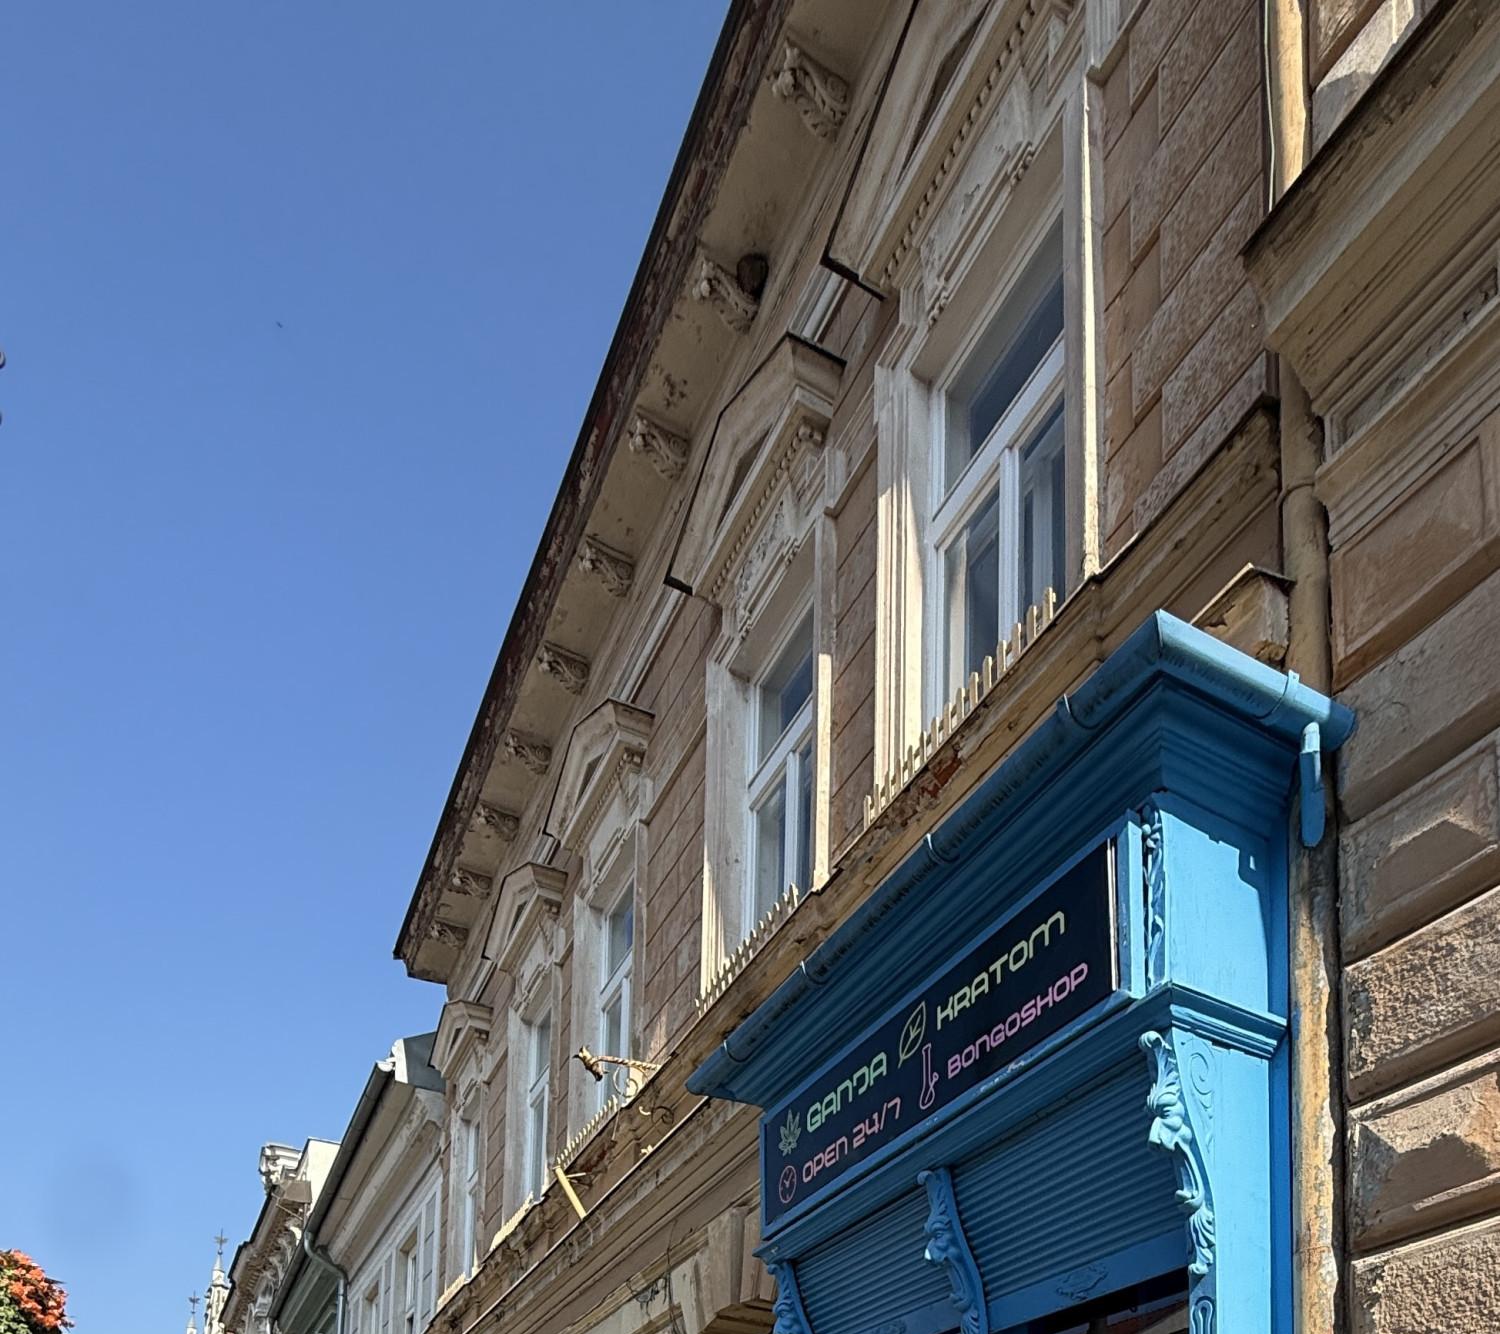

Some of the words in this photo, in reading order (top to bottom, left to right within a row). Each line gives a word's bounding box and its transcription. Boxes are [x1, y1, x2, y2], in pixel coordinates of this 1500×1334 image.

[803, 1136, 848, 1183] OPEN
[853, 1096, 901, 1149] 24/7
[948, 962, 1089, 1079] BONGOSHOP
[807, 1052, 887, 1133] GANJA
[937, 911, 1065, 1031] KRATOM
